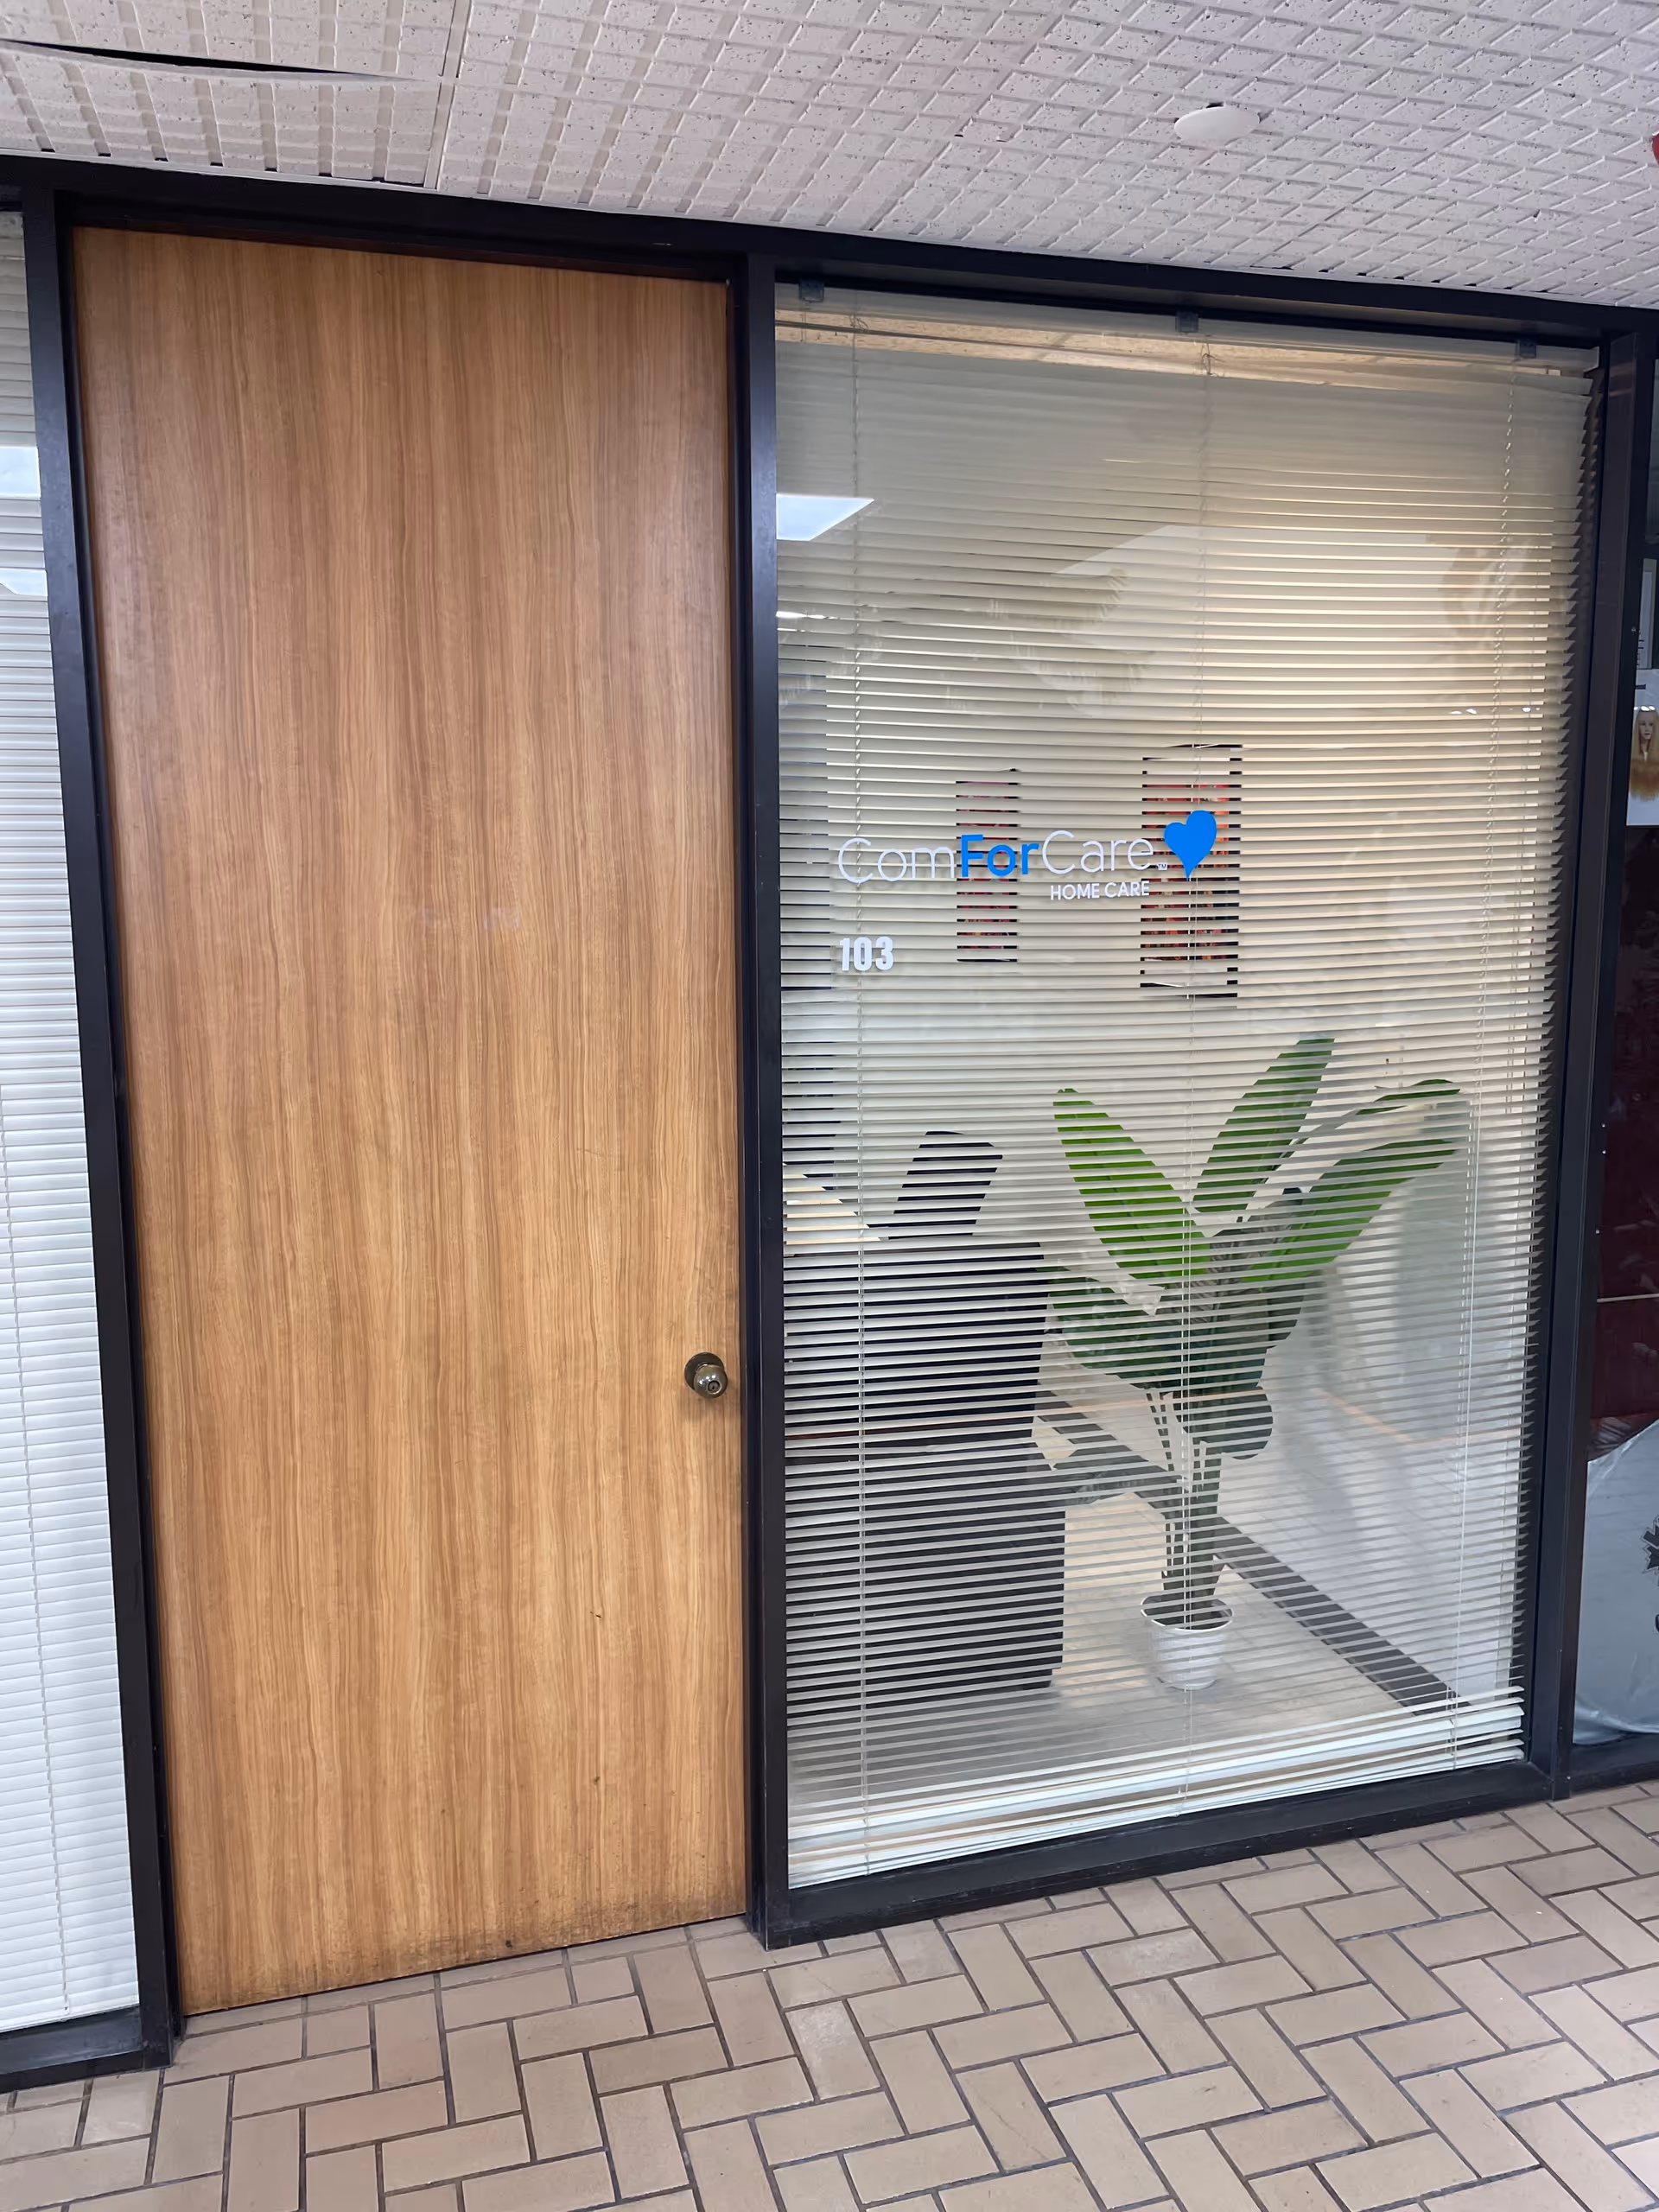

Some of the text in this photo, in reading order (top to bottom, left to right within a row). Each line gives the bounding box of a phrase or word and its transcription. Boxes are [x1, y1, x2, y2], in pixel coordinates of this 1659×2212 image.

[838, 830, 1154, 884] ComForCare
[1050, 880, 1150, 900] HOME CARE
[840, 936, 894, 971] 103
